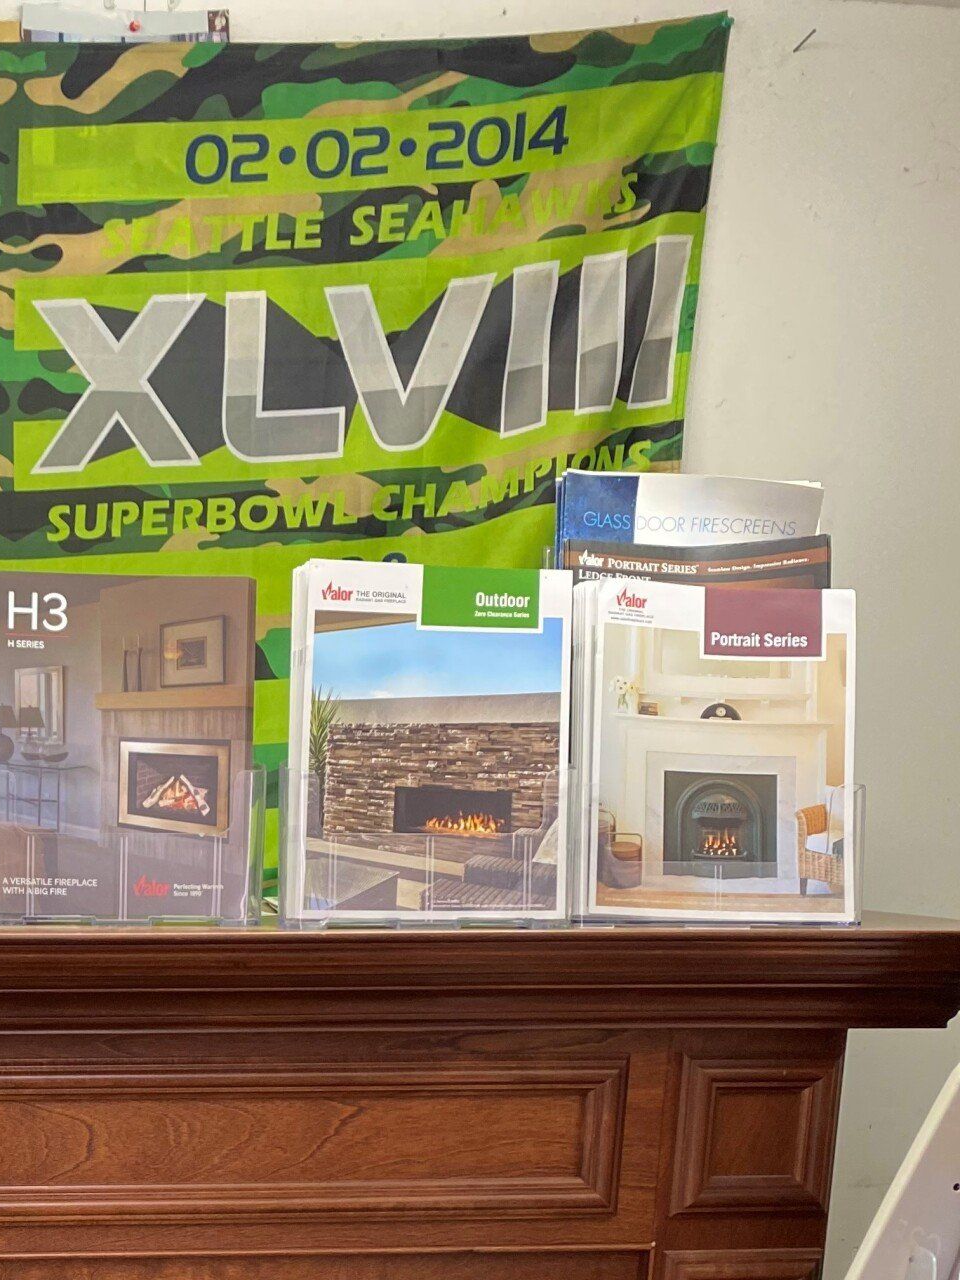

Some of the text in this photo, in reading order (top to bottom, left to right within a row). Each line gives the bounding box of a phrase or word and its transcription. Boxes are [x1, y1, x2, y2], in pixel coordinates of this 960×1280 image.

[102, 172, 639, 258] SEATTLE SEAHAWKS
[30, 234, 694, 475] XLVIII
[46, 440, 652, 542] SUPERBOWL CHAMPIONS
[583, 511, 797, 536] GLASS DOOR FIRESCREENS
[608, 557, 660, 573] PORTRAIT
[356, 590, 370, 598] THE
[371, 591, 407, 599] ORIGINAL
[475, 591, 530, 608] Outdoor
[7, 590, 68, 632] H3
[7, 639, 45, 649] H SERIES
[711, 631, 808, 648] Portrait Series
[2, 877, 98, 887] A VERSATILE FIREPLACE
[2, 886, 25, 895] WITH
[34, 887, 49, 895] BIG
[49, 887, 68, 896] FIRE
